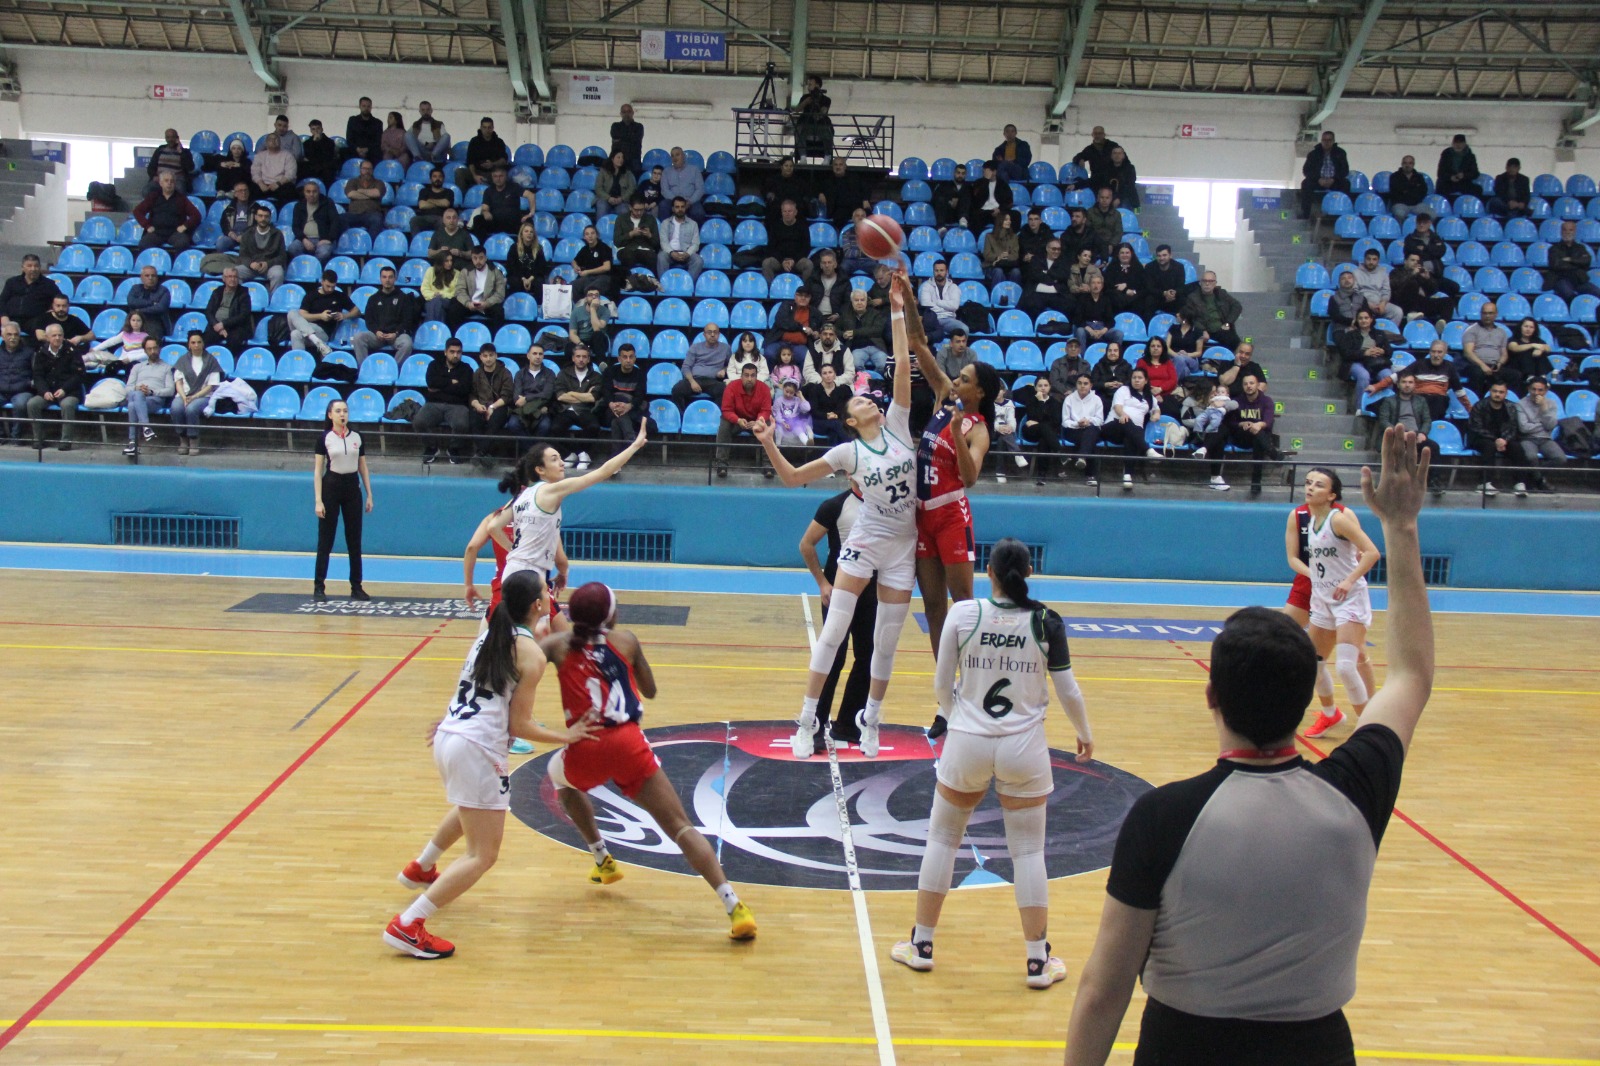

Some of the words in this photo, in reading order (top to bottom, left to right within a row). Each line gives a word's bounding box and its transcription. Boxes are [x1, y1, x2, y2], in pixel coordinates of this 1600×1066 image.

[675, 33, 719, 45] TRİBÜN
[681, 48, 712, 57] ORTA
[1292, 235, 1300, 243] K
[1276, 310, 1285, 319] G
[1309, 370, 1316, 378] E
[1275, 403, 1283, 412] D
[1327, 404, 1335, 413] D
[1293, 440, 1302, 448] C
[1344, 441, 1353, 449] C
[864, 467, 882, 487] DSİ
[885, 459, 914, 481] SPOR
[924, 465, 939, 485] 15
[886, 480, 910, 503] 23
[294, 607, 452, 616] HALKBANK
[980, 632, 1026, 649] ERDEN
[965, 654, 995, 669] HILLY
[1000, 656, 1039, 673] HOTEL
[449, 680, 494, 720] 35
[585, 677, 630, 722] 14
[983, 678, 1013, 719] 6
[500, 776, 510, 795] 3
